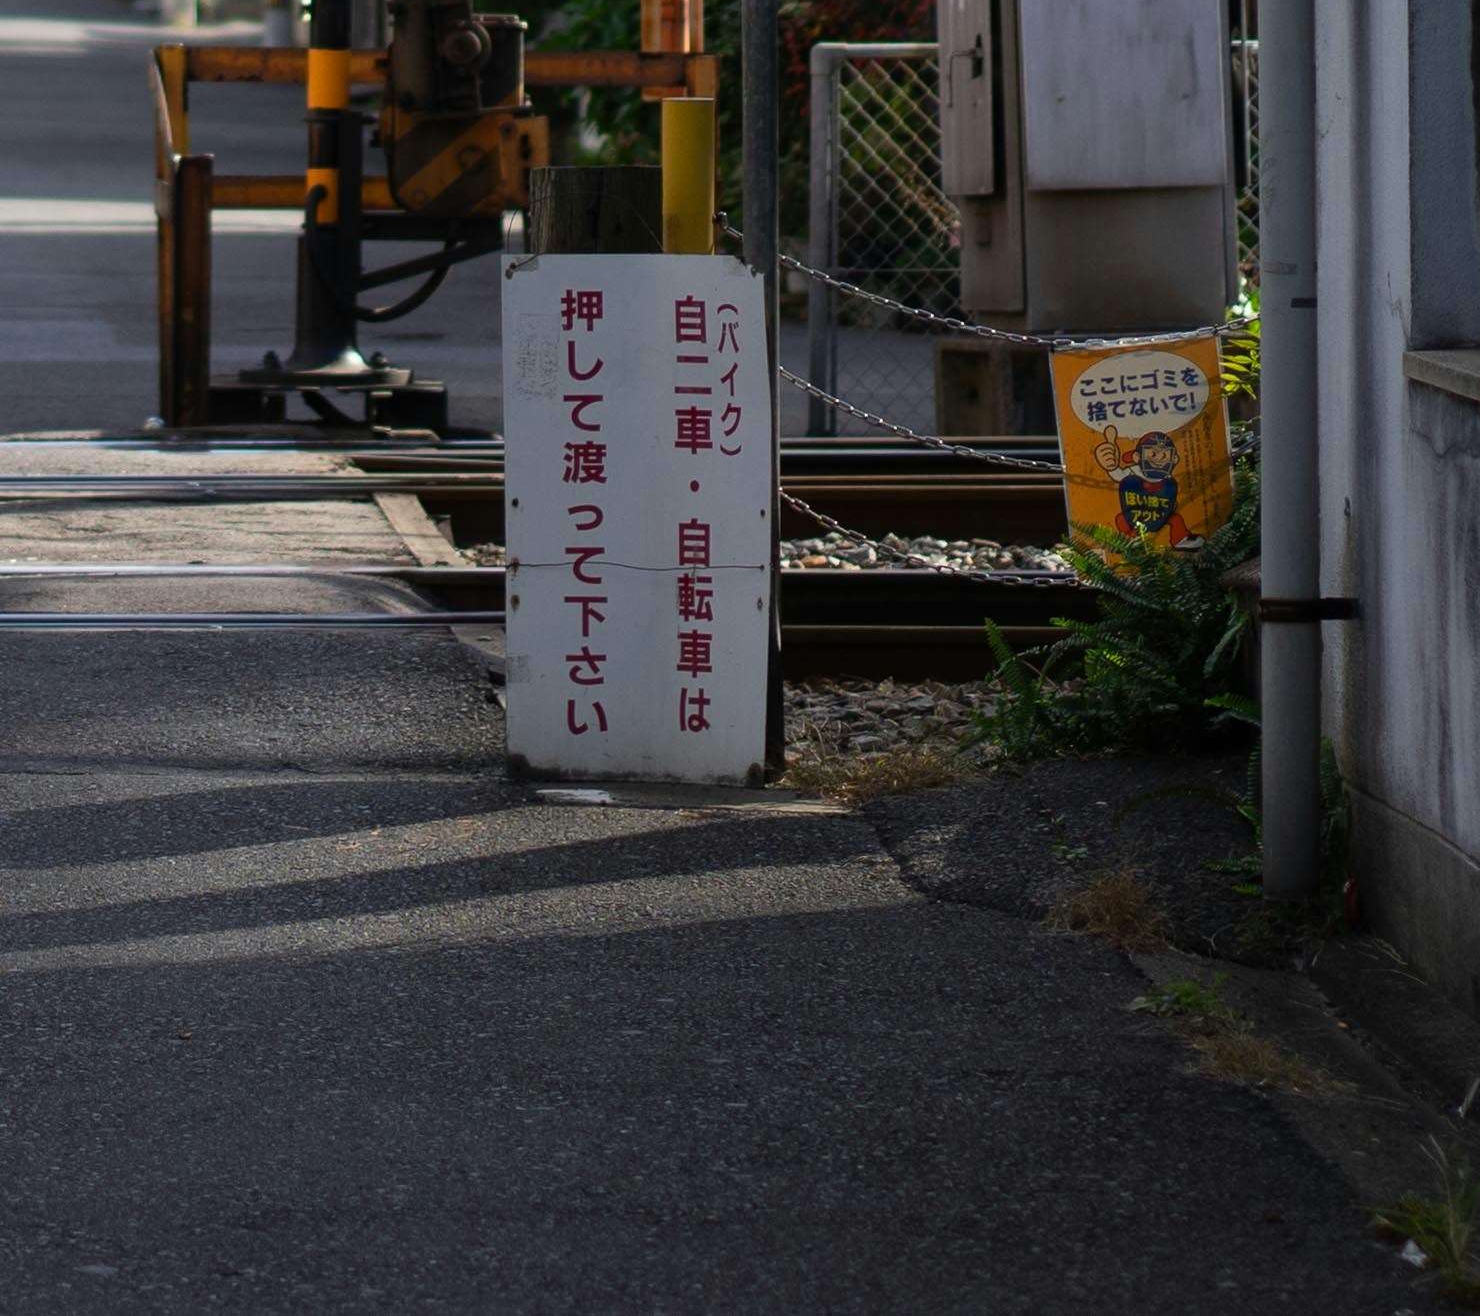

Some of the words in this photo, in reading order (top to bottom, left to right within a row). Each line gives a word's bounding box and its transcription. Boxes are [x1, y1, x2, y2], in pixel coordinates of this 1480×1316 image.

[1079, 367, 1200, 397] ここにゴミを
[1086, 391, 1197, 423] 捨てないで!
[560, 288, 609, 736] 押して渡って下さい
[673, 294, 715, 733] 自二車・自転車は
